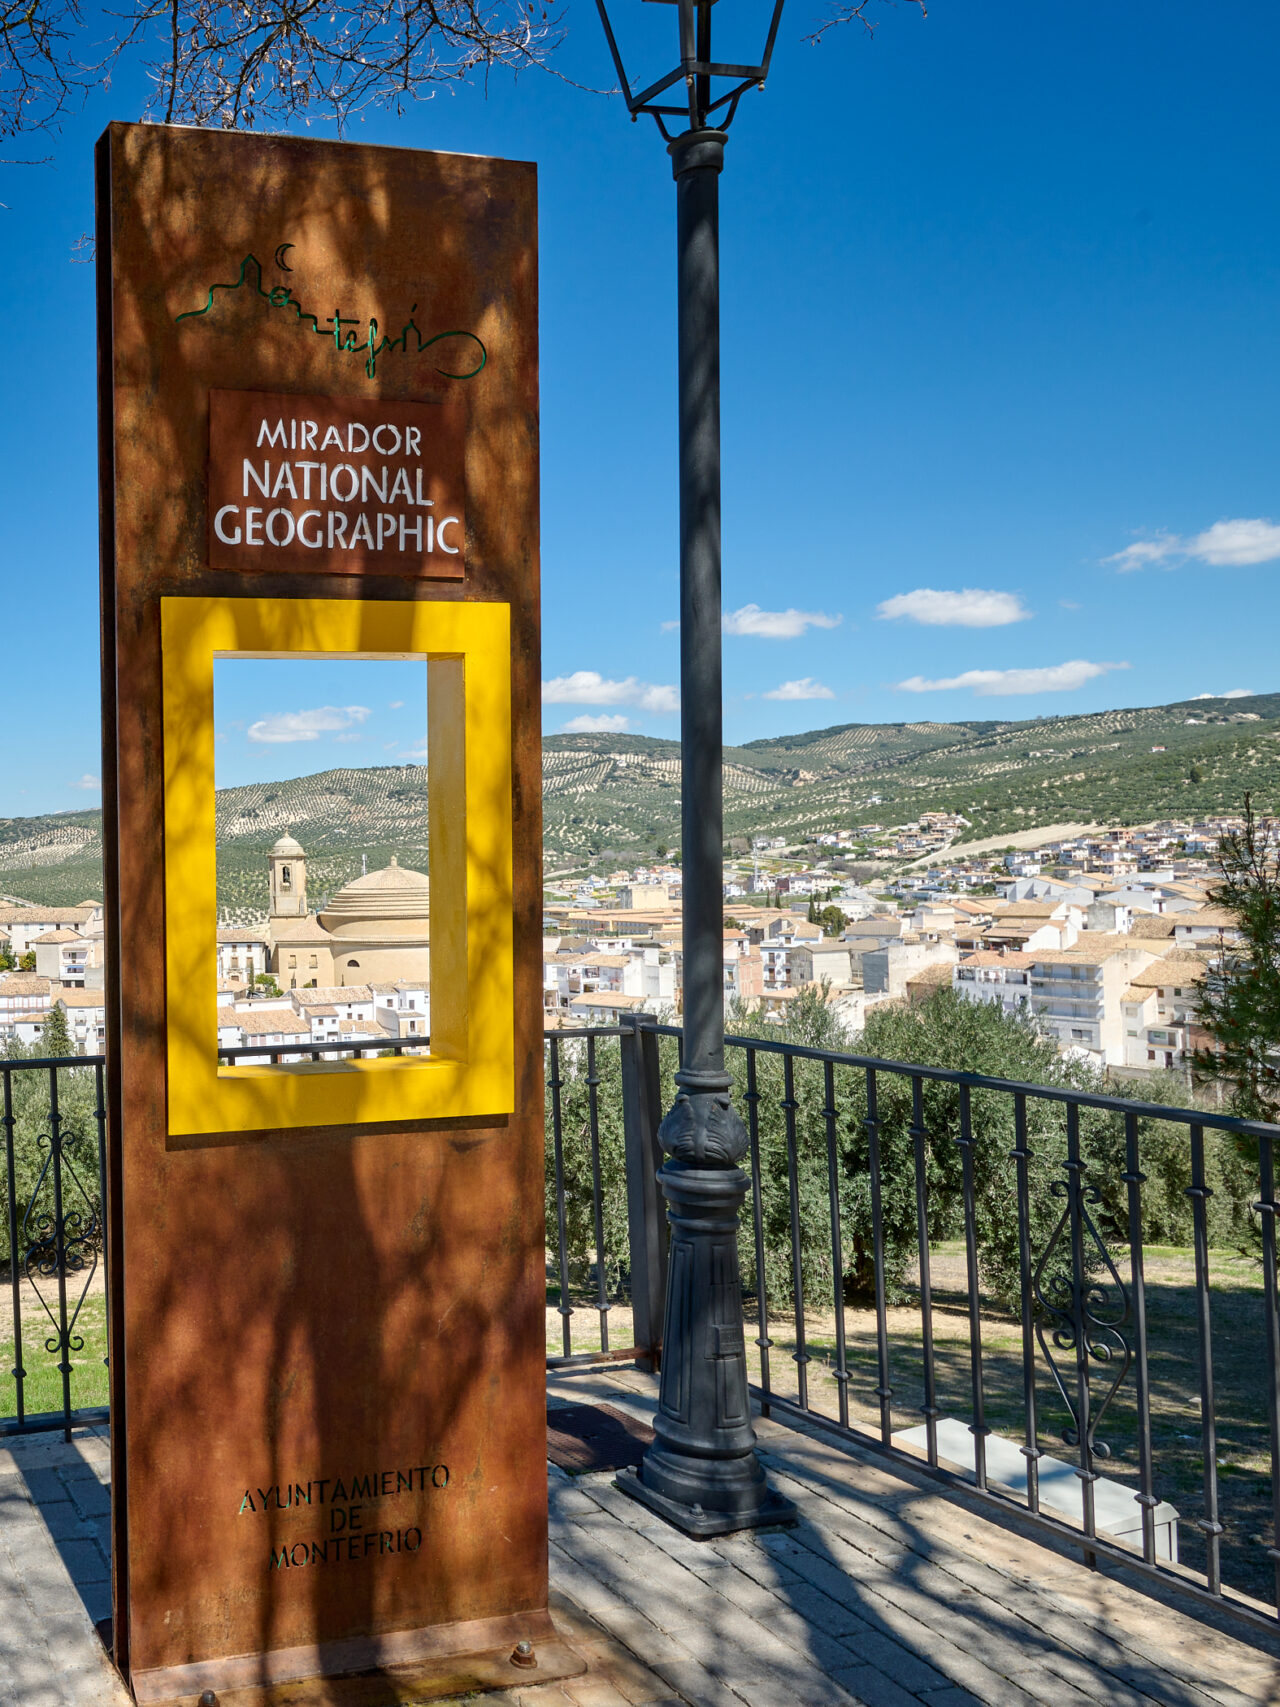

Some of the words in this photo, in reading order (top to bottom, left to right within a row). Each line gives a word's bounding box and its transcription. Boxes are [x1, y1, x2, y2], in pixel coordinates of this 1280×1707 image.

[256, 418, 422, 457] MIRADOR
[242, 458, 434, 506] NATIONAL
[213, 504, 460, 555] GEOGRAPHIC
[238, 1464, 450, 1515] AYUNTAMIENTO
[330, 1505, 363, 1533] DE
[269, 1527, 423, 1569] MONTEFRIO
